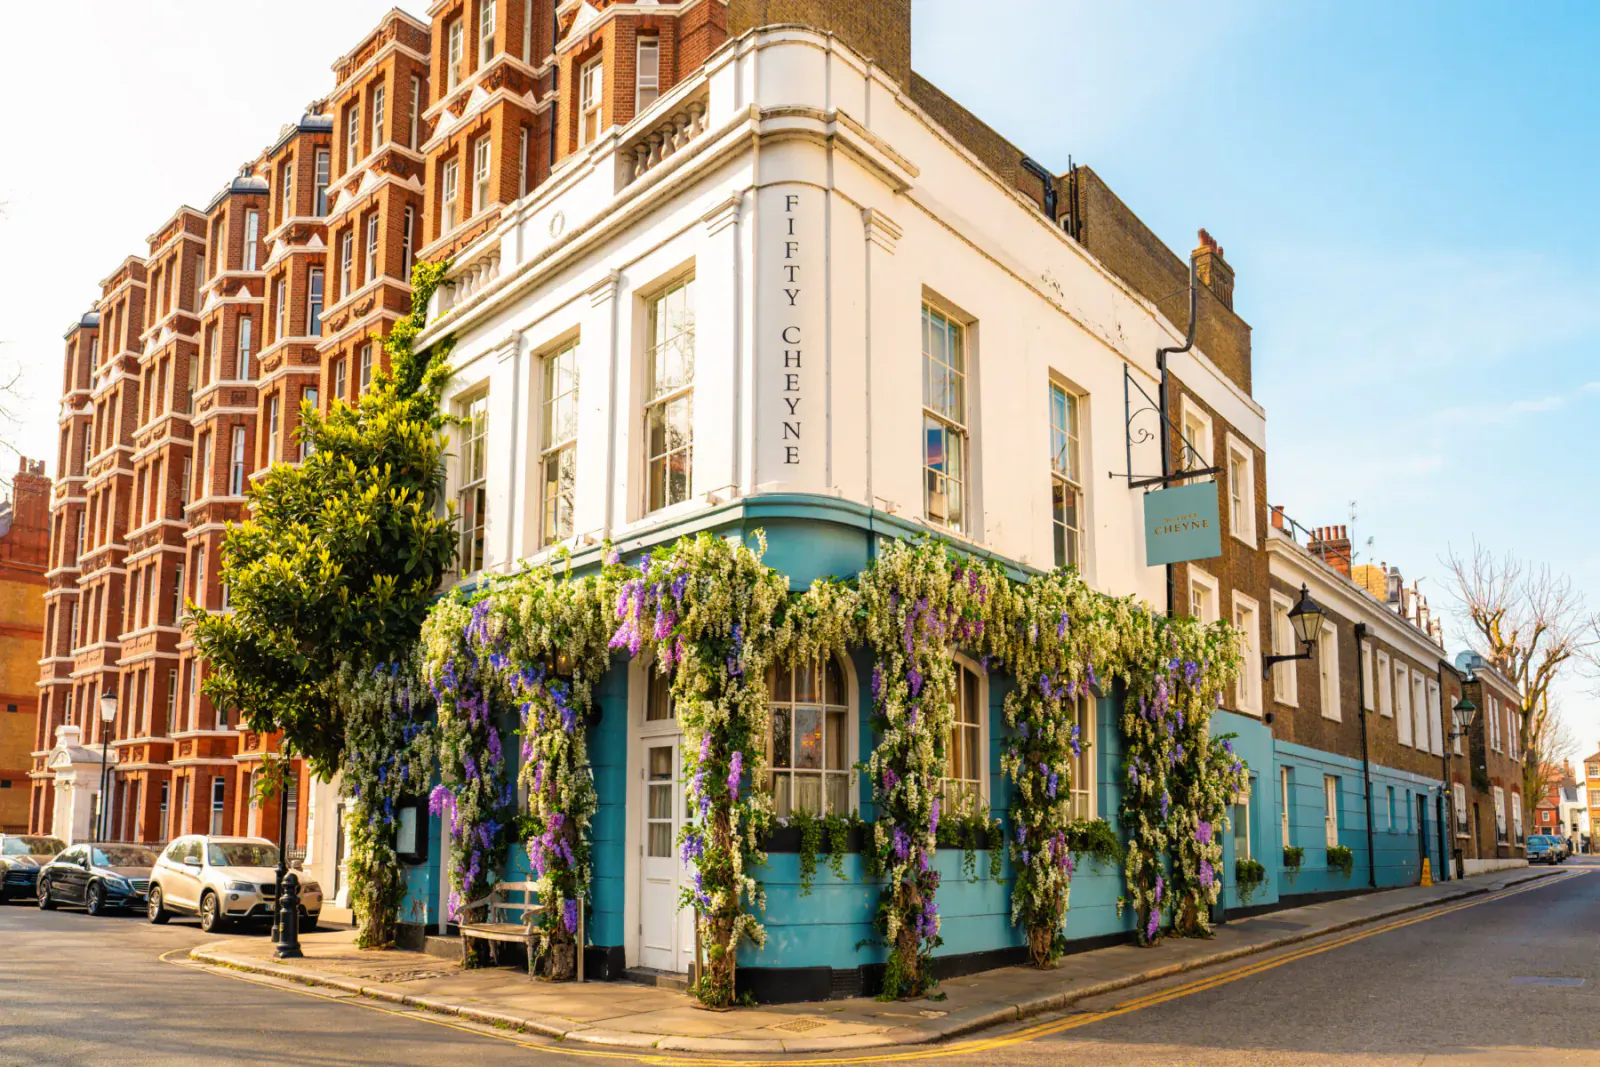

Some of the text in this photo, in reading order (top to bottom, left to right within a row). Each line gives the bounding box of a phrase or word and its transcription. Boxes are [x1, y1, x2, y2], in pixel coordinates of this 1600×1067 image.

[782, 195, 802, 464] FIFTY CHEYNE
[1154, 519, 1209, 536] CHEYNE
